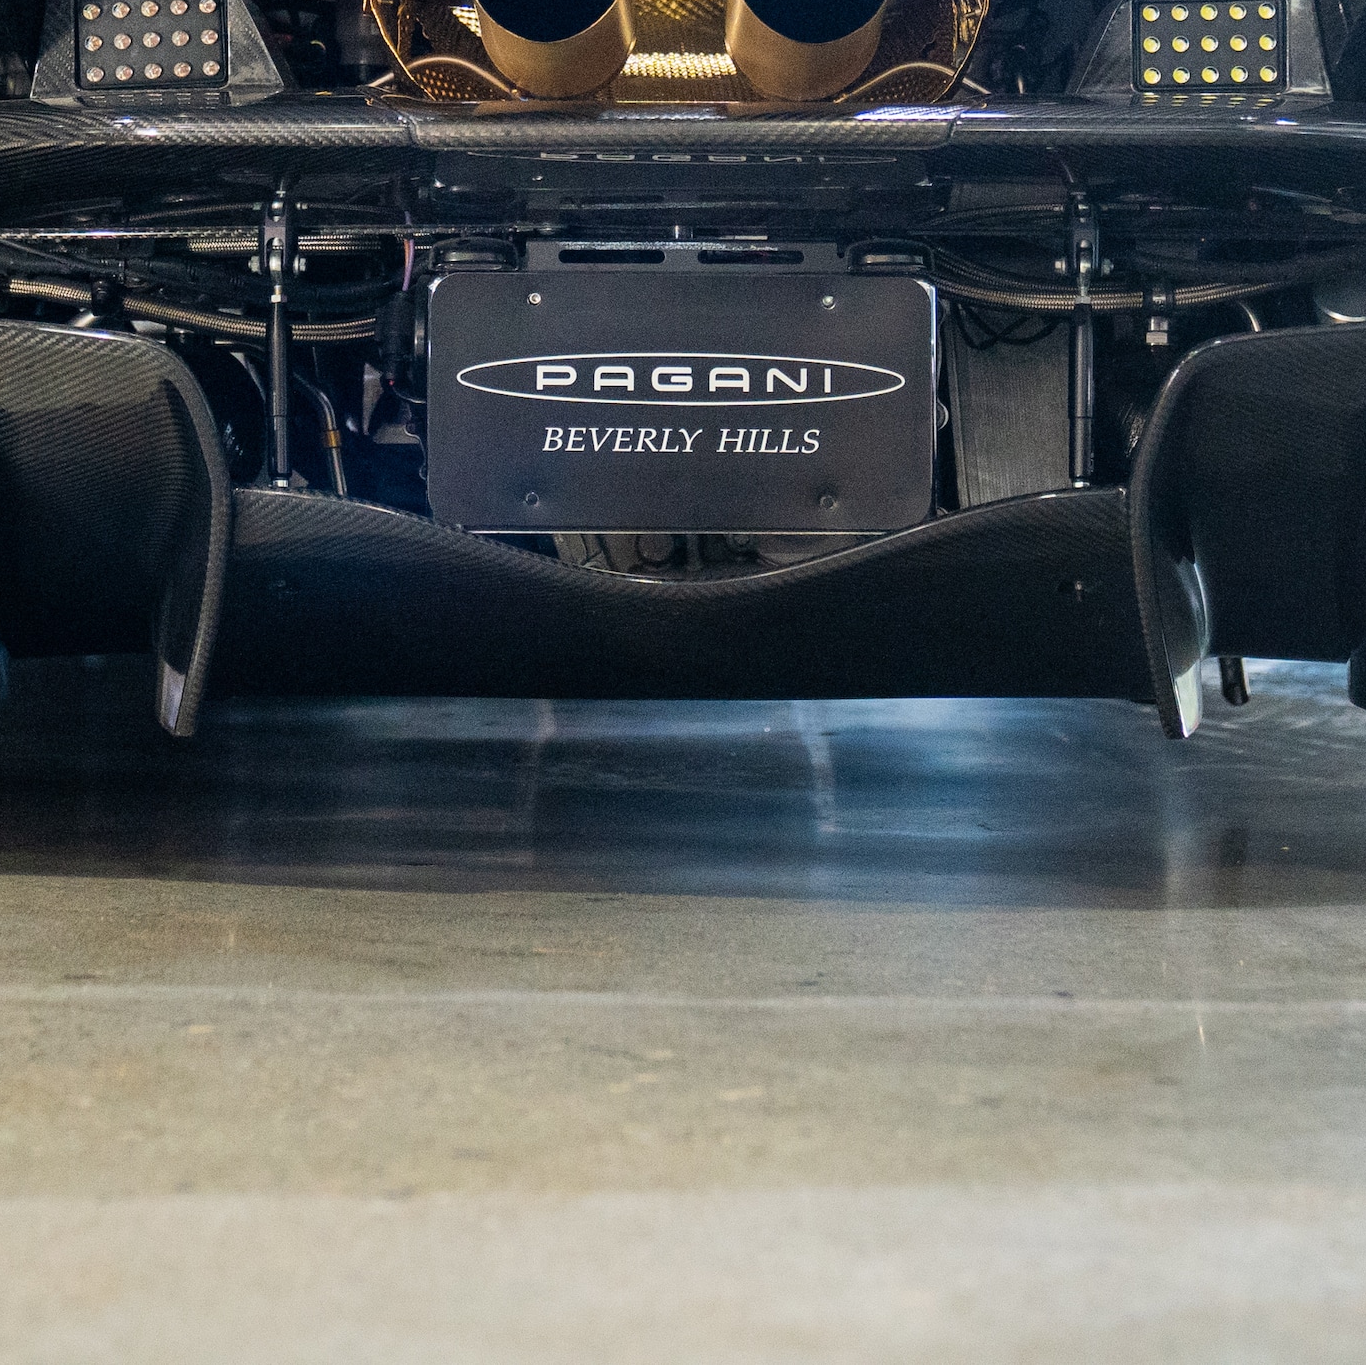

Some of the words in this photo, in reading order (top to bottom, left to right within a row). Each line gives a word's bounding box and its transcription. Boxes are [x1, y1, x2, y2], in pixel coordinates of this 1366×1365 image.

[537, 365, 832, 392] PAGANI
[543, 427, 702, 452] BEVERLY
[717, 428, 820, 453] HILLS
